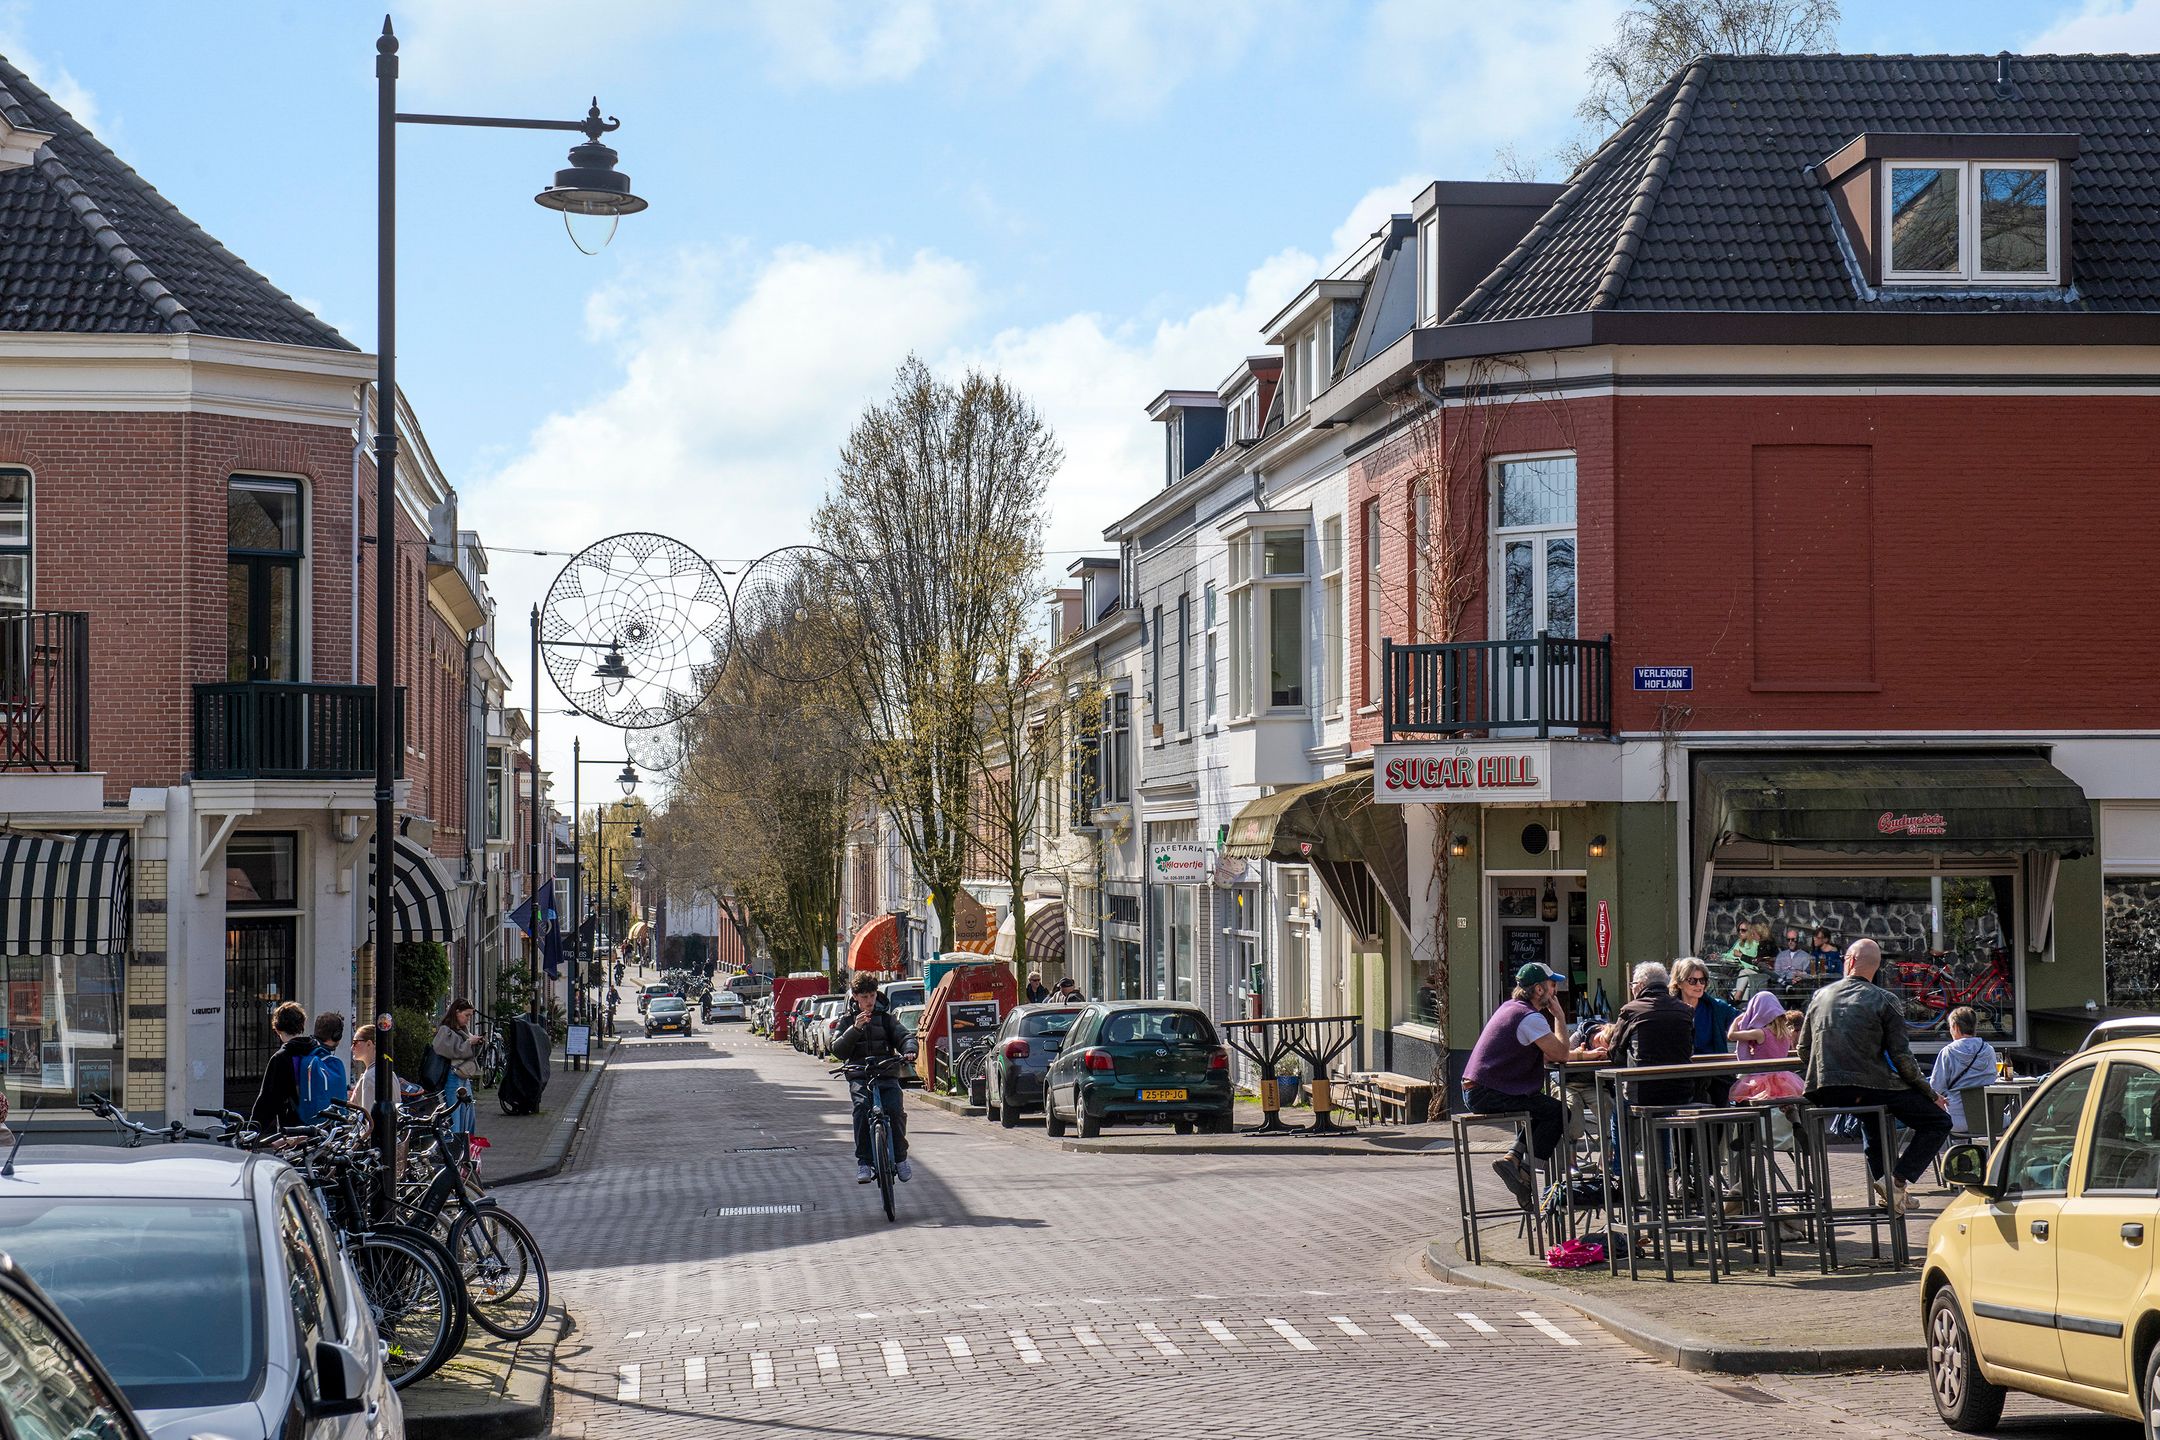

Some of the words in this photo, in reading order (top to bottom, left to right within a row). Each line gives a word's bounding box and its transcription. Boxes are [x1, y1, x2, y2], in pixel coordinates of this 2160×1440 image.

[1638, 669, 1688, 678] VERLENGDE
[1644, 679, 1683, 688] HOFLAAN
[1385, 757, 1475, 791] SUGAR
[1477, 755, 1540, 789] HILL
[1878, 811, 1947, 834] Budweiser
[1154, 844, 1203, 854] CAFETARIA
[1146, 1090, 1183, 1099] 25-FP-JG
